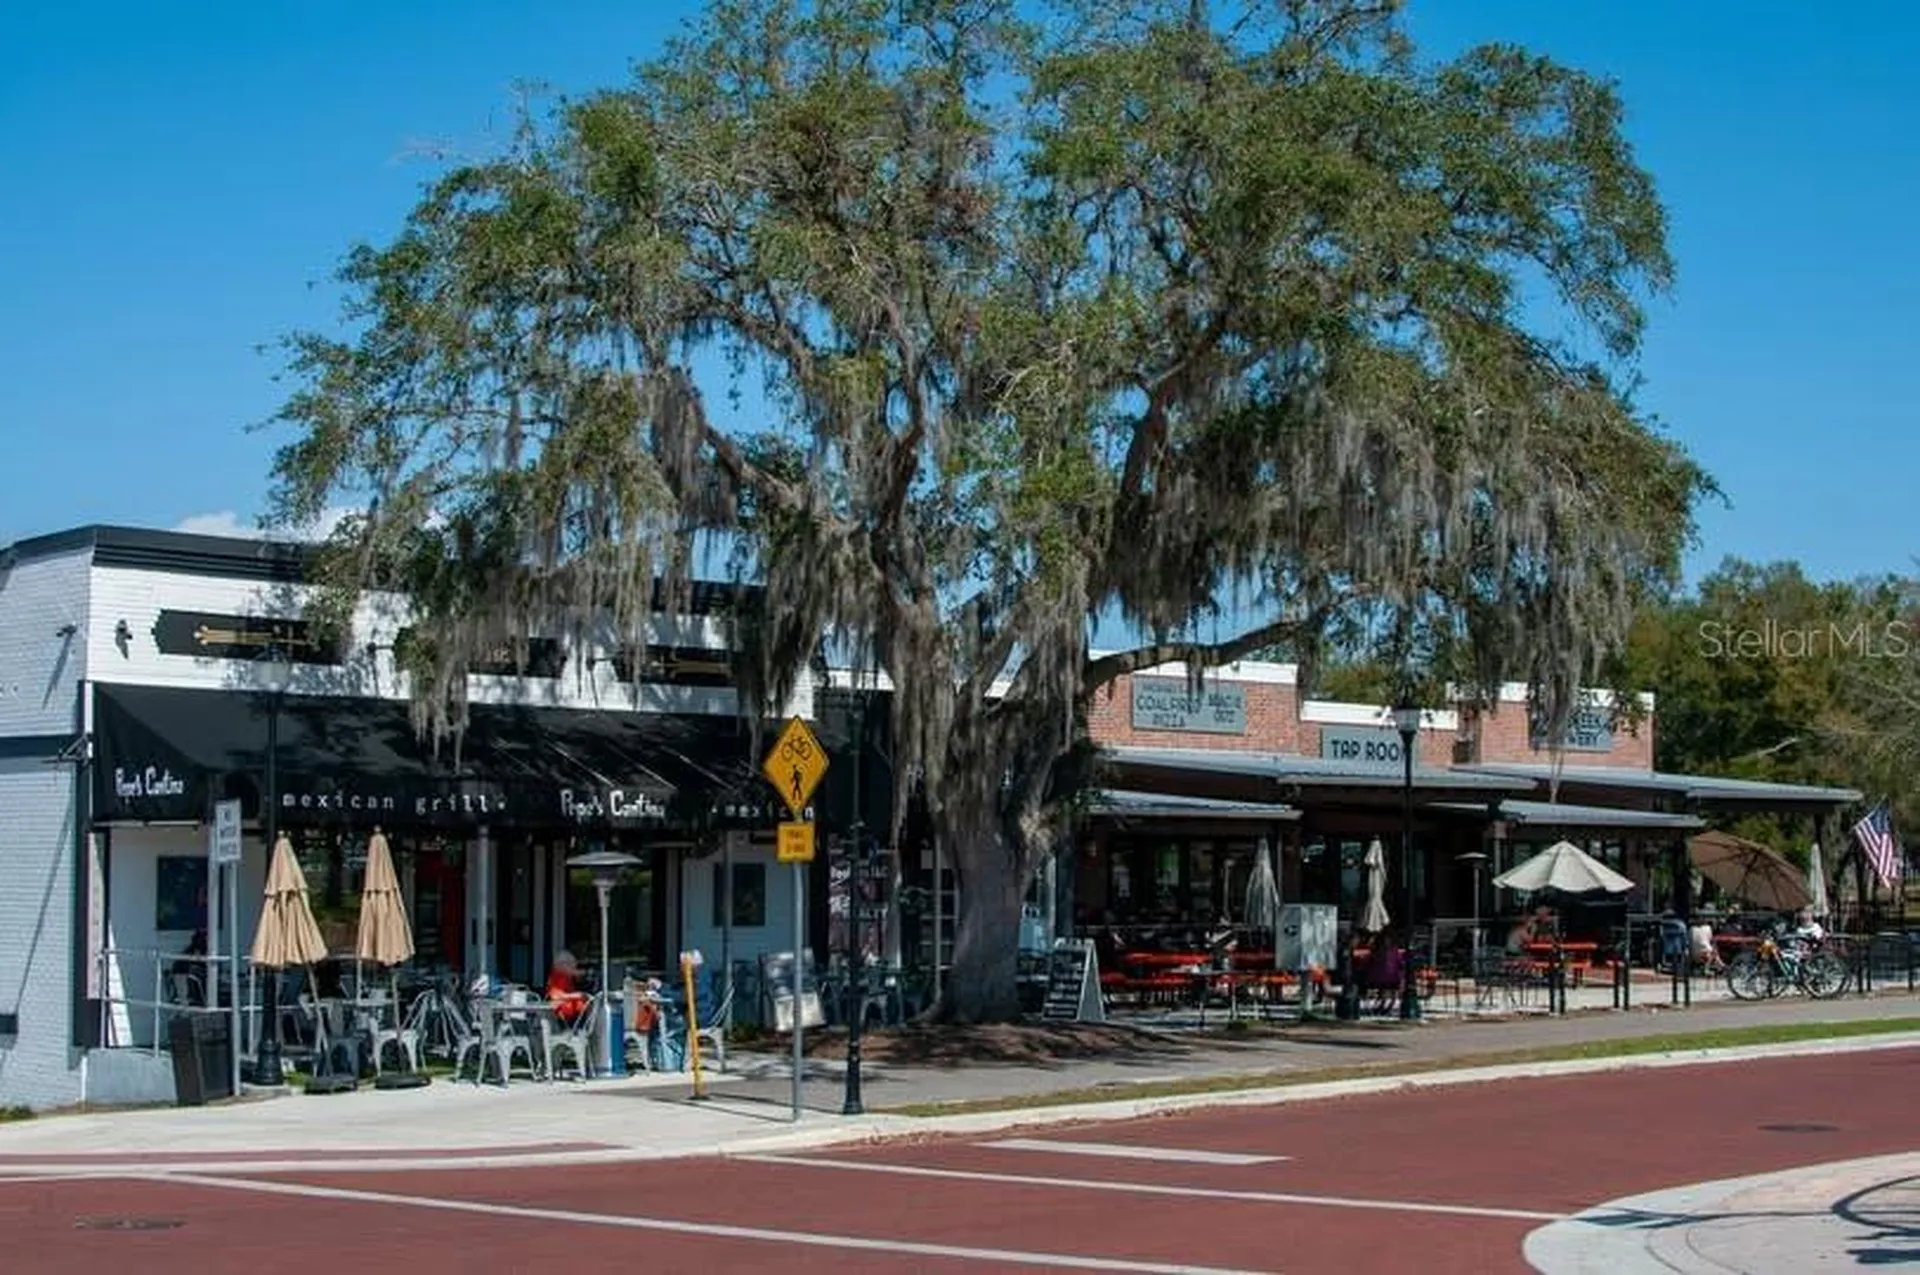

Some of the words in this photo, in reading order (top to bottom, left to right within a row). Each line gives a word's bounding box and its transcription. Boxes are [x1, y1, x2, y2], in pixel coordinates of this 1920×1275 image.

[1331, 740, 1360, 758] TAP
[1366, 741, 1400, 761] ROO
[145, 765, 184, 795] Cantina
[283, 790, 395, 809] mexican
[414, 792, 489, 816] grill
[610, 789, 665, 817] Cantina
[724, 804, 814, 819] mexicn
